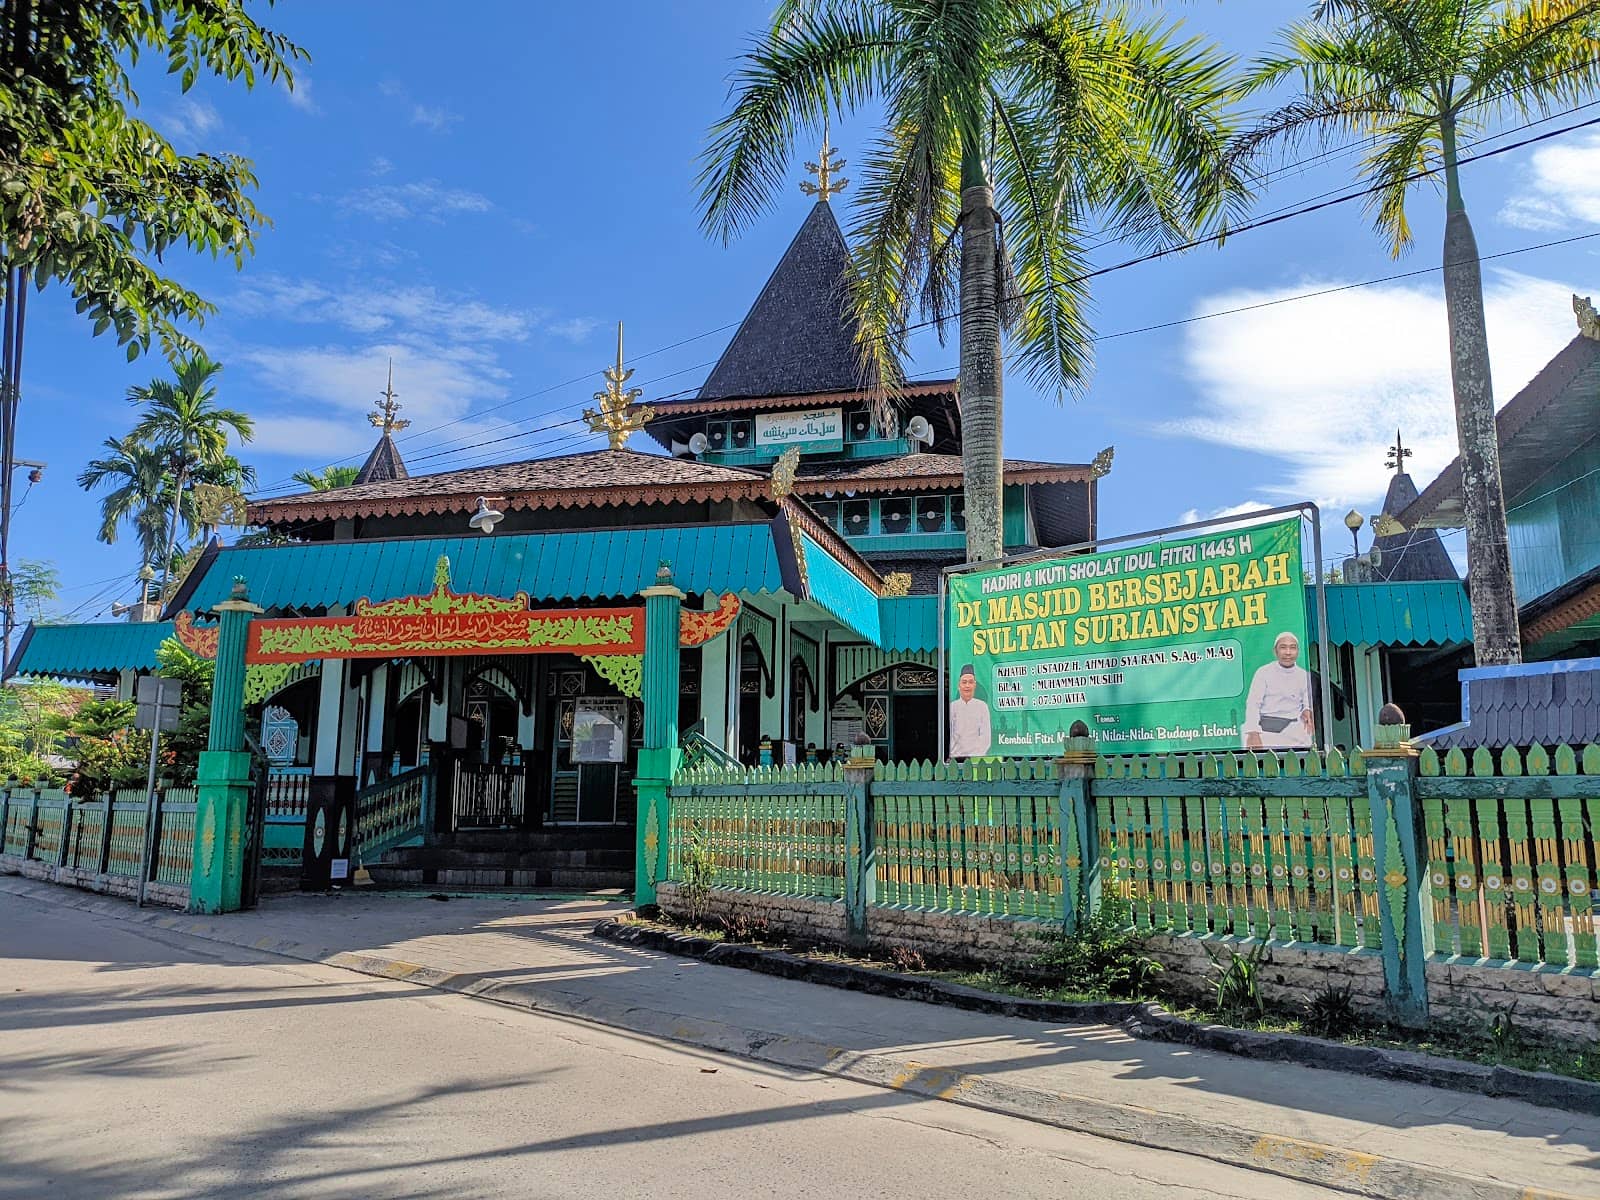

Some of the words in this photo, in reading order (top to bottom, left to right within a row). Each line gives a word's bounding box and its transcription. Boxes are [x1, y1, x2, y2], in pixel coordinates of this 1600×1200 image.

[803, 411, 836, 420] مسجد
[799, 421, 836, 437] سلطان
[982, 574, 1021, 594] HADIRI
[1024, 571, 1032, 588] &
[1035, 567, 1066, 586] IKUTI
[1069, 556, 1122, 581] SHOLAT
[1124, 551, 1156, 573] IDUL
[1160, 544, 1197, 567] FITRI
[1200, 537, 1235, 560] 1443
[1239, 534, 1252, 554] H
[957, 600, 982, 628] DI
[987, 586, 1082, 625] MASJID
[1087, 552, 1291, 612] BERSEJARAH
[973, 620, 1067, 657] SULTAN
[1074, 592, 1268, 646] SURIANSYAH
[1037, 662, 1070, 674] USTADZ
[1072, 661, 1081, 671] H.
[1085, 657, 1118, 670] AHMAD
[1206, 646, 1234, 660] M.Ag
[998, 682, 1022, 692] BILAL
[1037, 676, 1087, 690] MUHAMMAD
[1089, 672, 1124, 685] MUSLIH
[1038, 694, 1062, 706] 07.30
[1065, 692, 1086, 704] WITA
[998, 732, 1033, 745] Kembali
[1035, 731, 1055, 744] Fitri
[1102, 726, 1154, 742] Nilai-Nilai
[1156, 725, 1200, 741] Budaya
[1202, 723, 1238, 737] Islami
